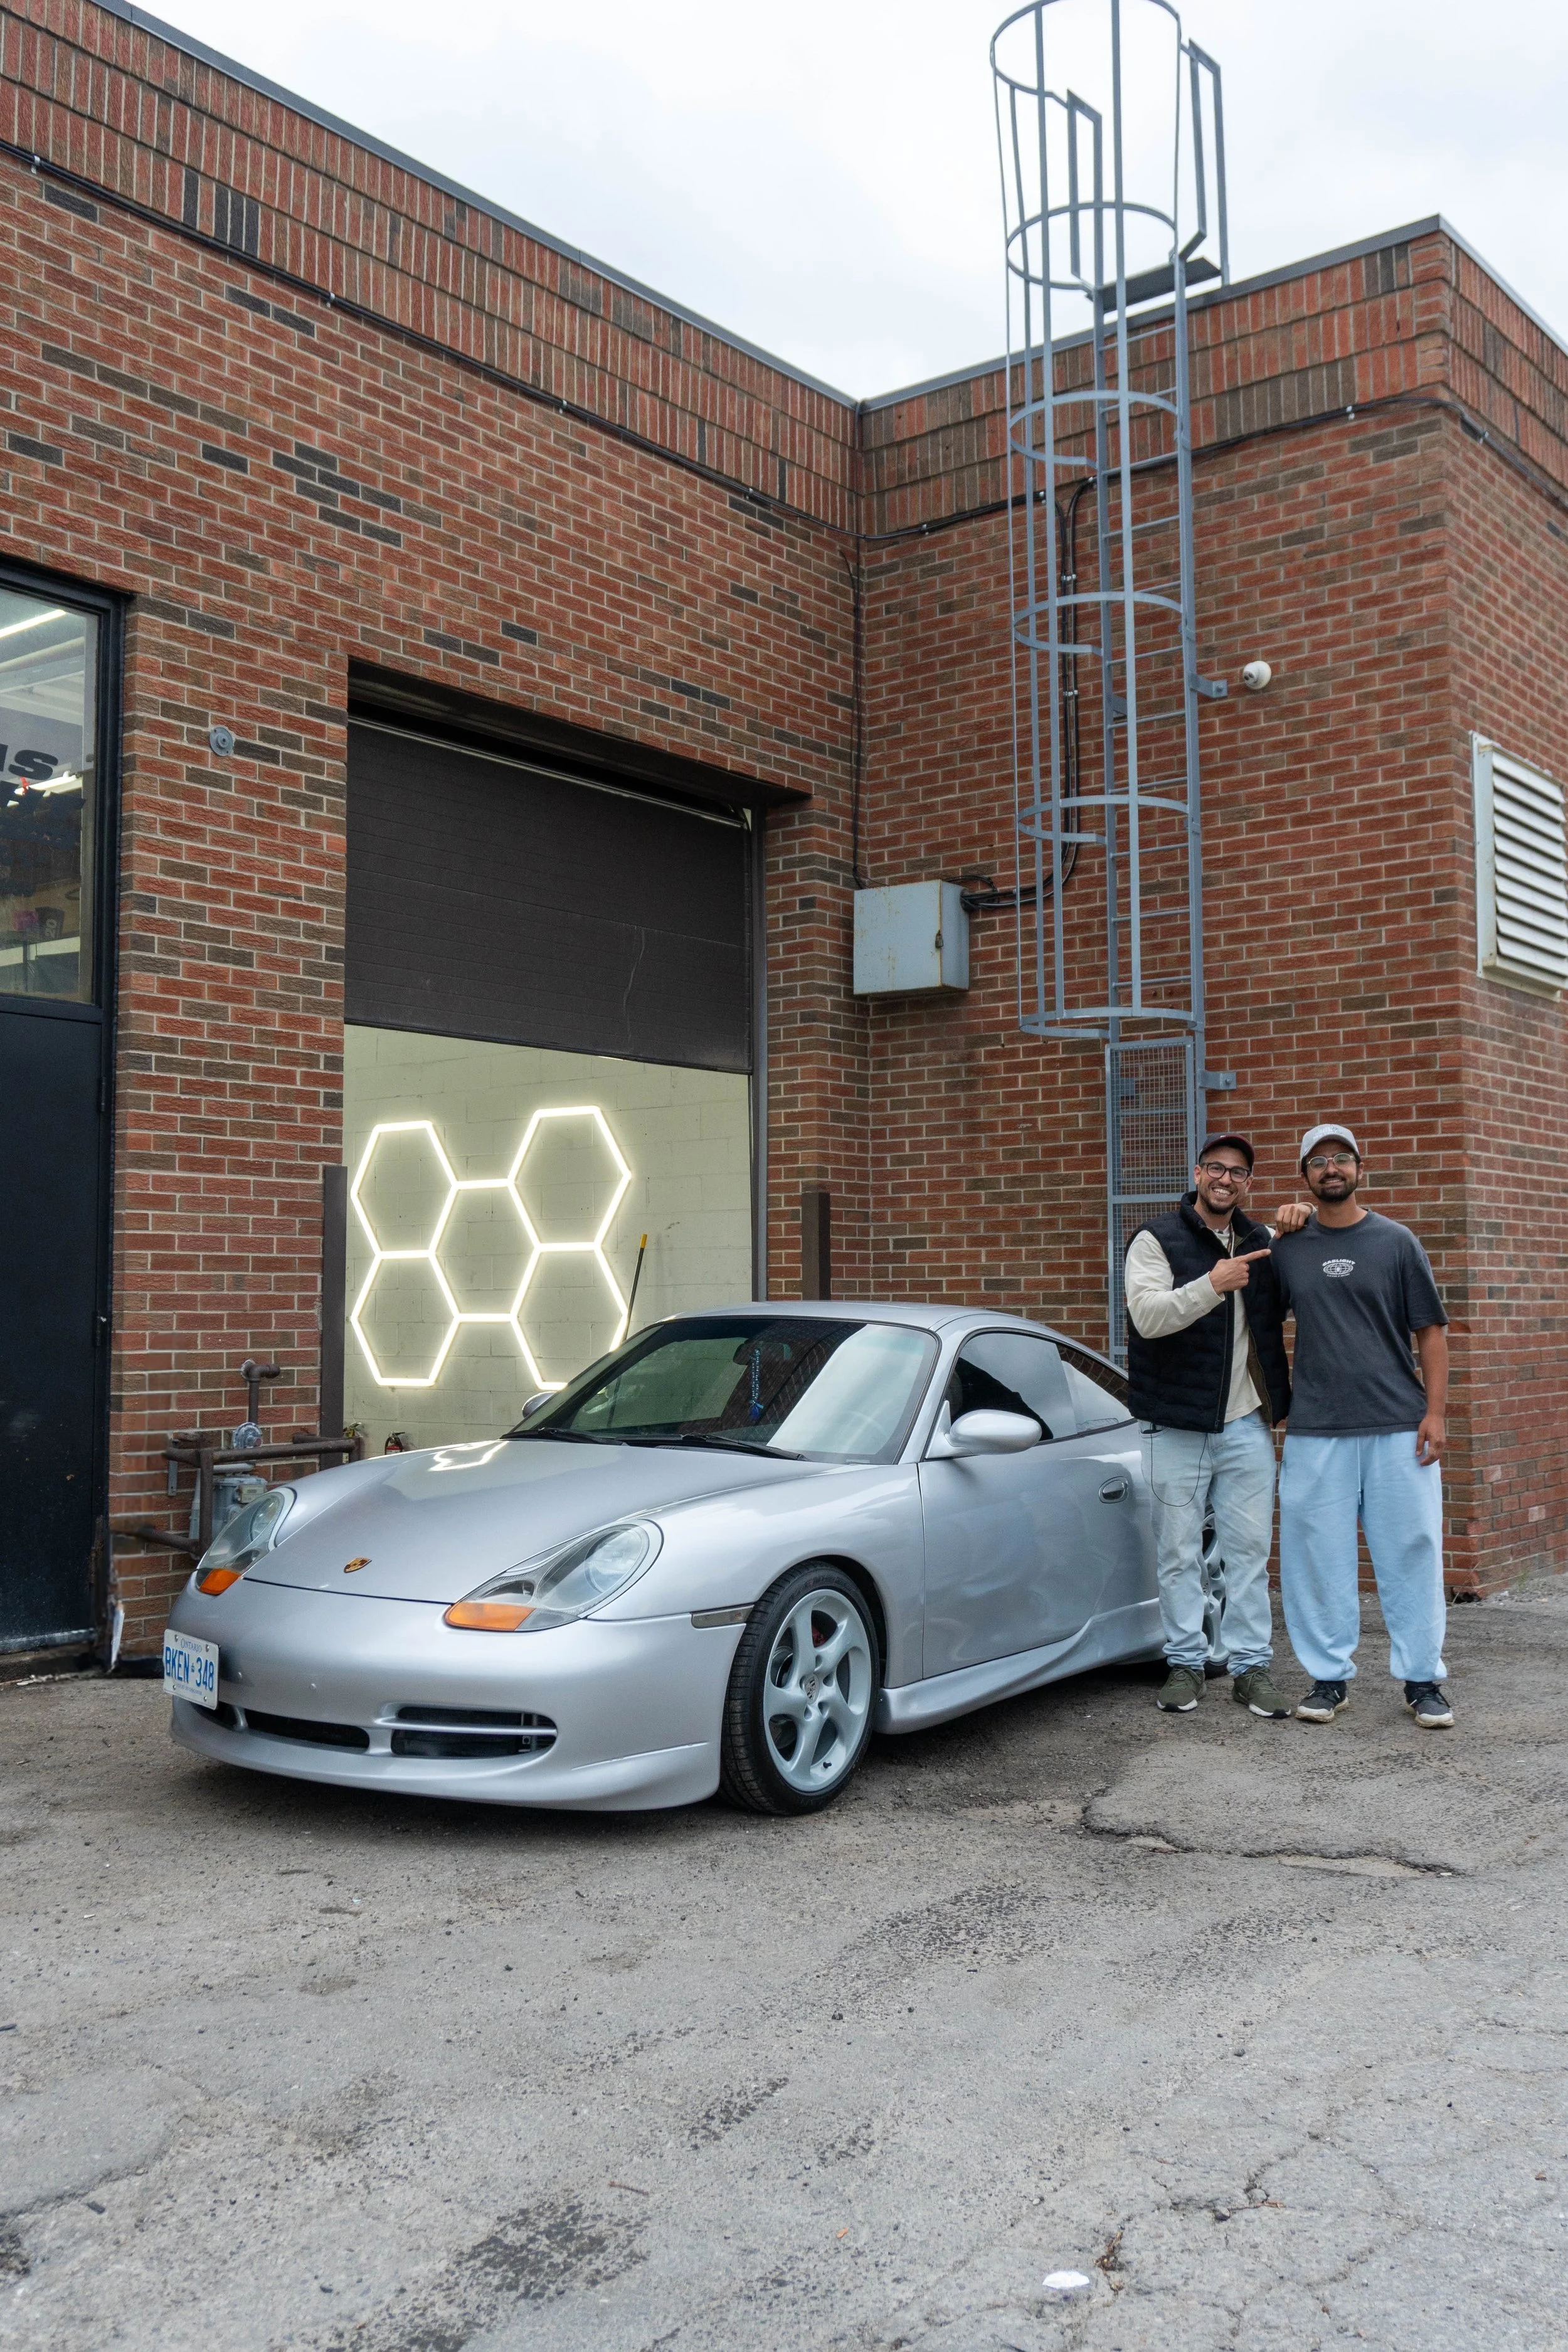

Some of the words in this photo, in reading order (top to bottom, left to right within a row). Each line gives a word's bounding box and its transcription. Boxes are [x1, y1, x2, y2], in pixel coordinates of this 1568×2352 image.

[181, 1638, 202, 1653] ONTARIO
[165, 1646, 189, 1683] BKEN
[196, 1657, 214, 1692] 348
